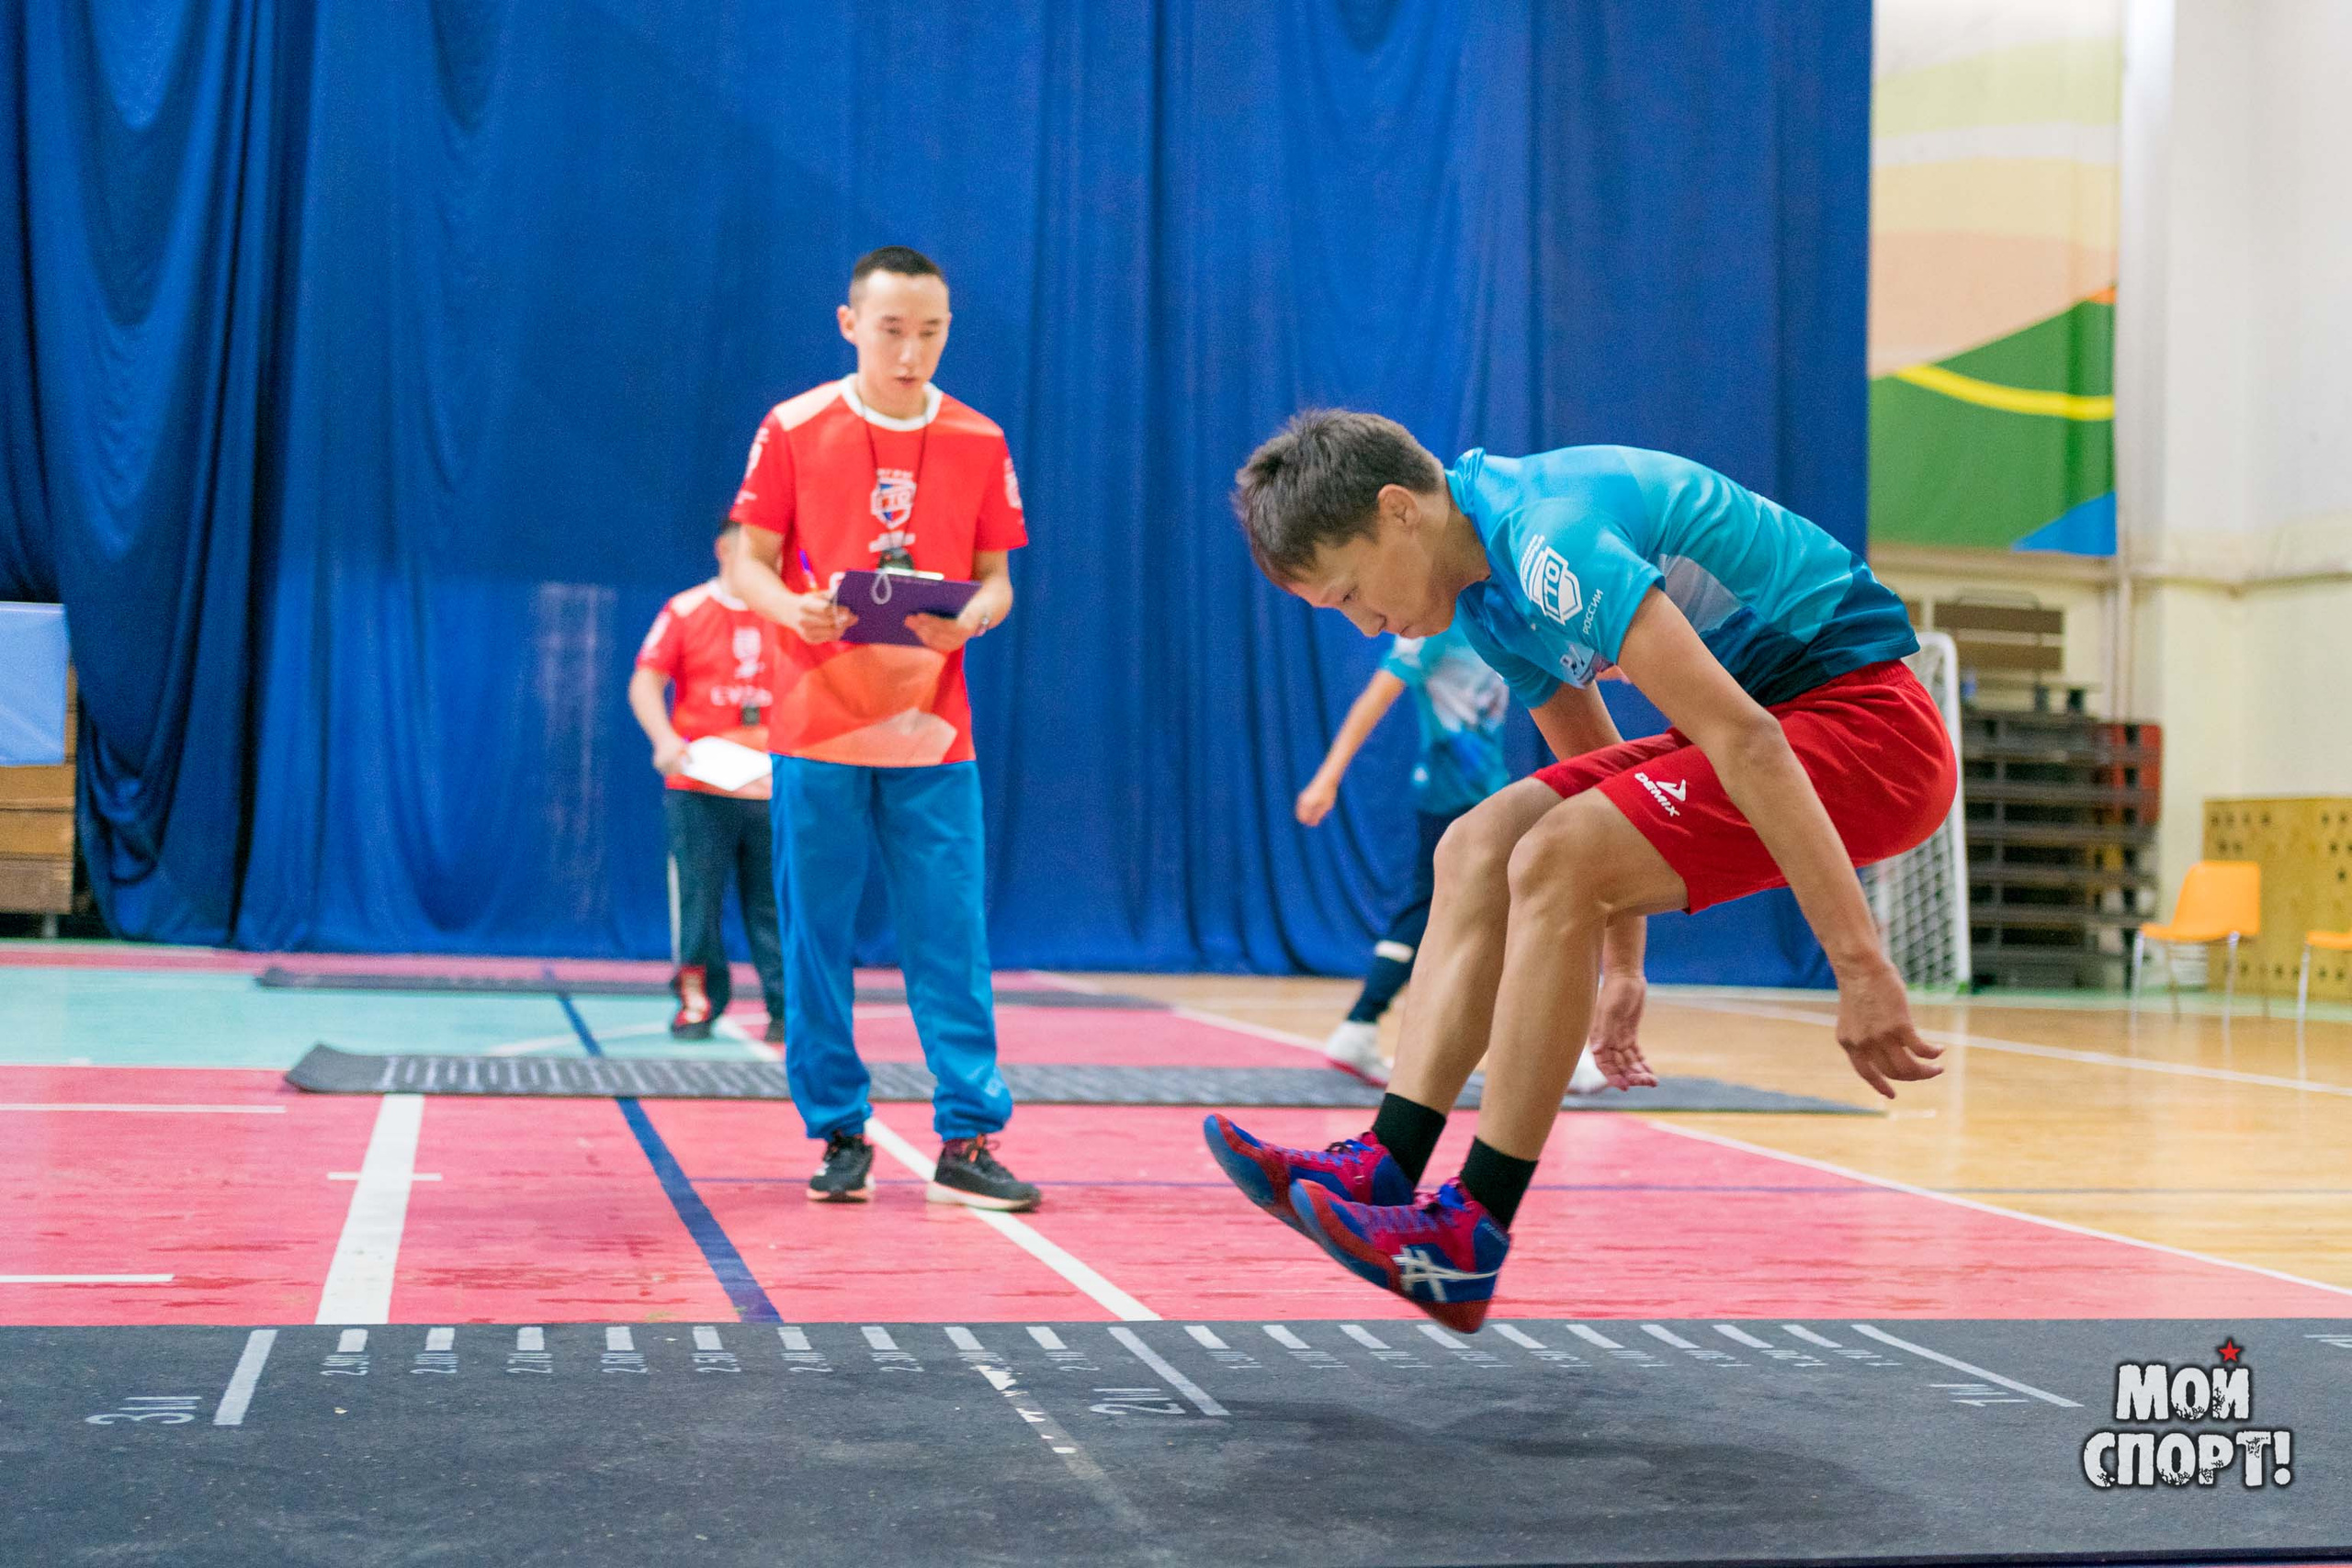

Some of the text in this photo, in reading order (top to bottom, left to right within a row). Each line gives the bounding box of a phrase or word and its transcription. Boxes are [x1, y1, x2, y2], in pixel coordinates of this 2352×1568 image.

[1544, 559, 1561, 616] ГТО
[1582, 588, 1604, 635] РОССИИ
[1634, 772, 1680, 817] DEMIX
